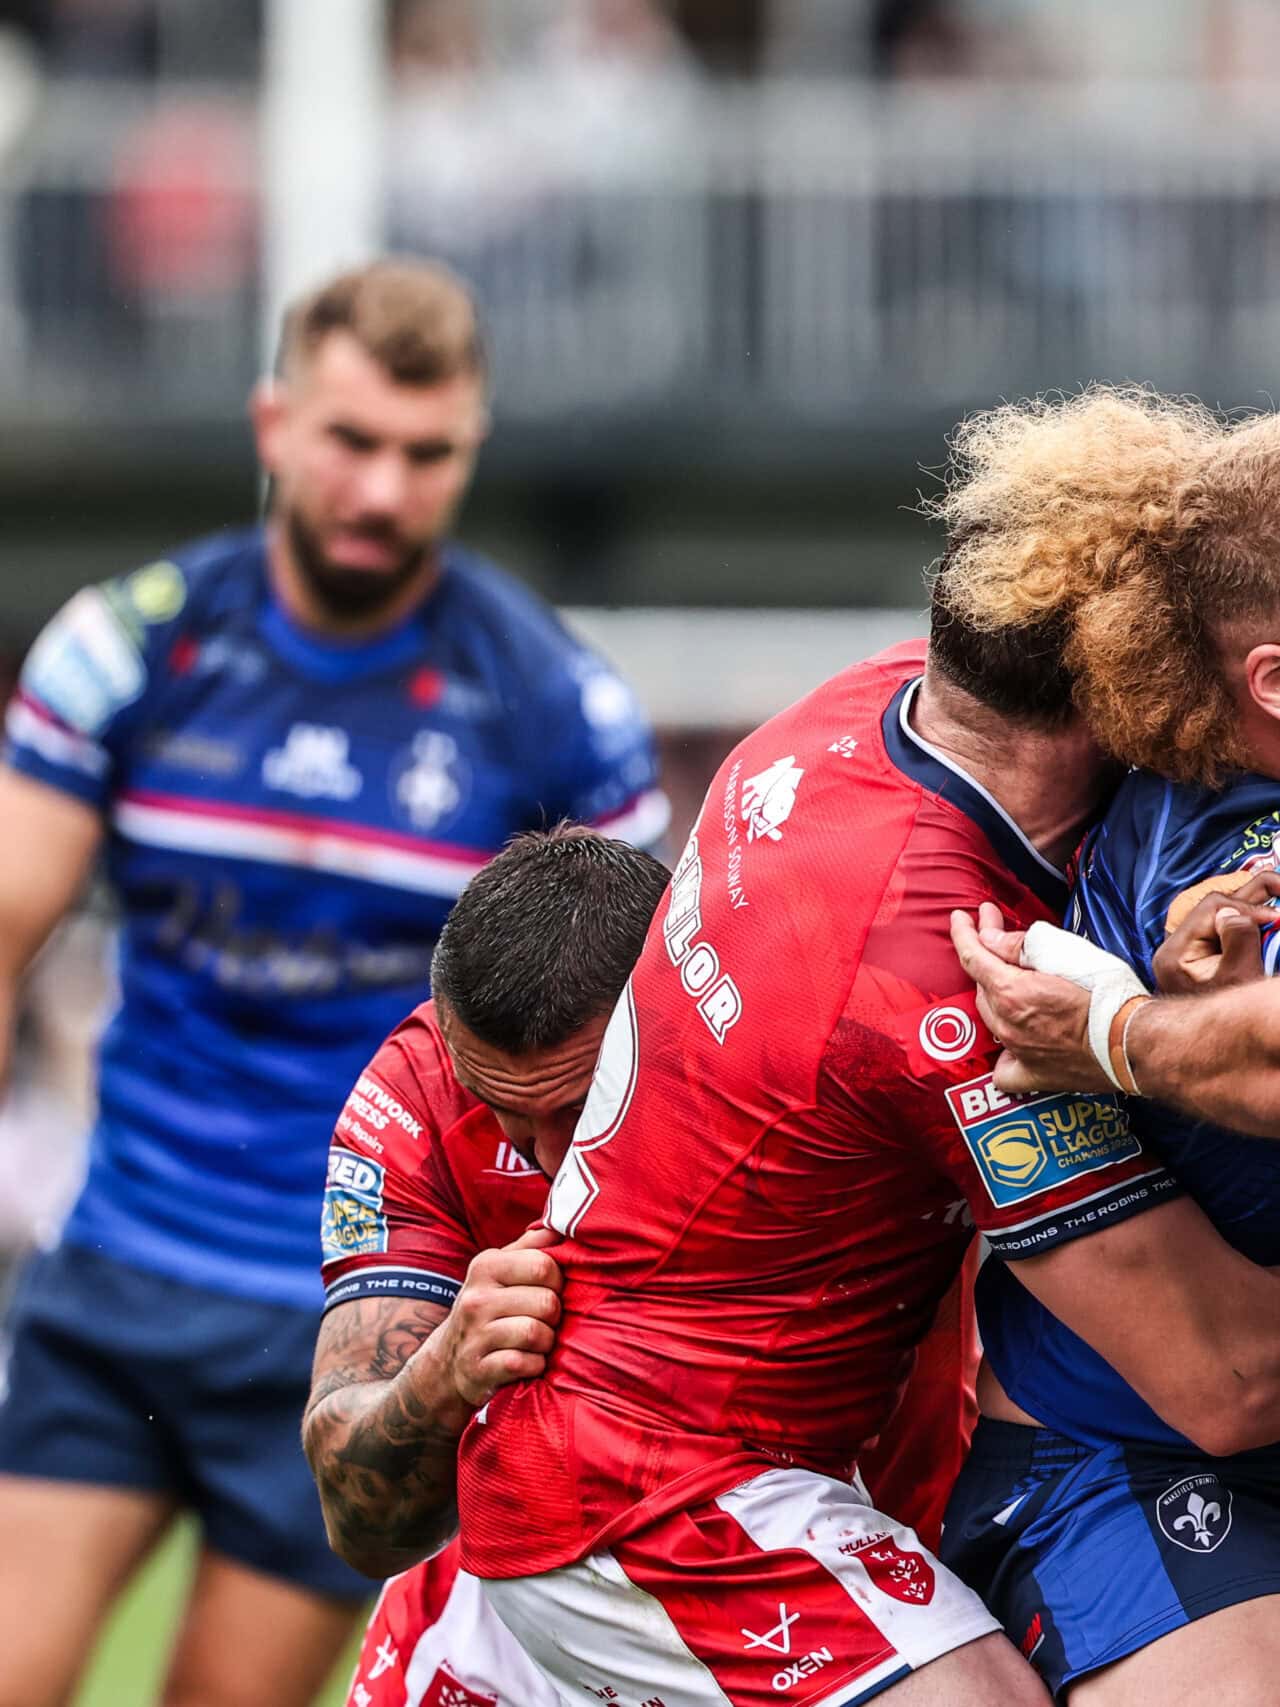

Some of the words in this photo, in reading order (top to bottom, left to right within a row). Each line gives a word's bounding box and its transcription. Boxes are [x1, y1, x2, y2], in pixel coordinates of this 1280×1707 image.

[723, 759, 743, 846] HARRISON
[728, 846, 749, 910] SOLWAY
[1064, 1211, 1097, 1230] THE
[1099, 1187, 1149, 1218] ROBINS
[366, 1278, 400, 1290] THE
[402, 1280, 458, 1300] ROBIN
[838, 1535, 876, 1556] HULL
[771, 1646, 834, 1691] OXEN
